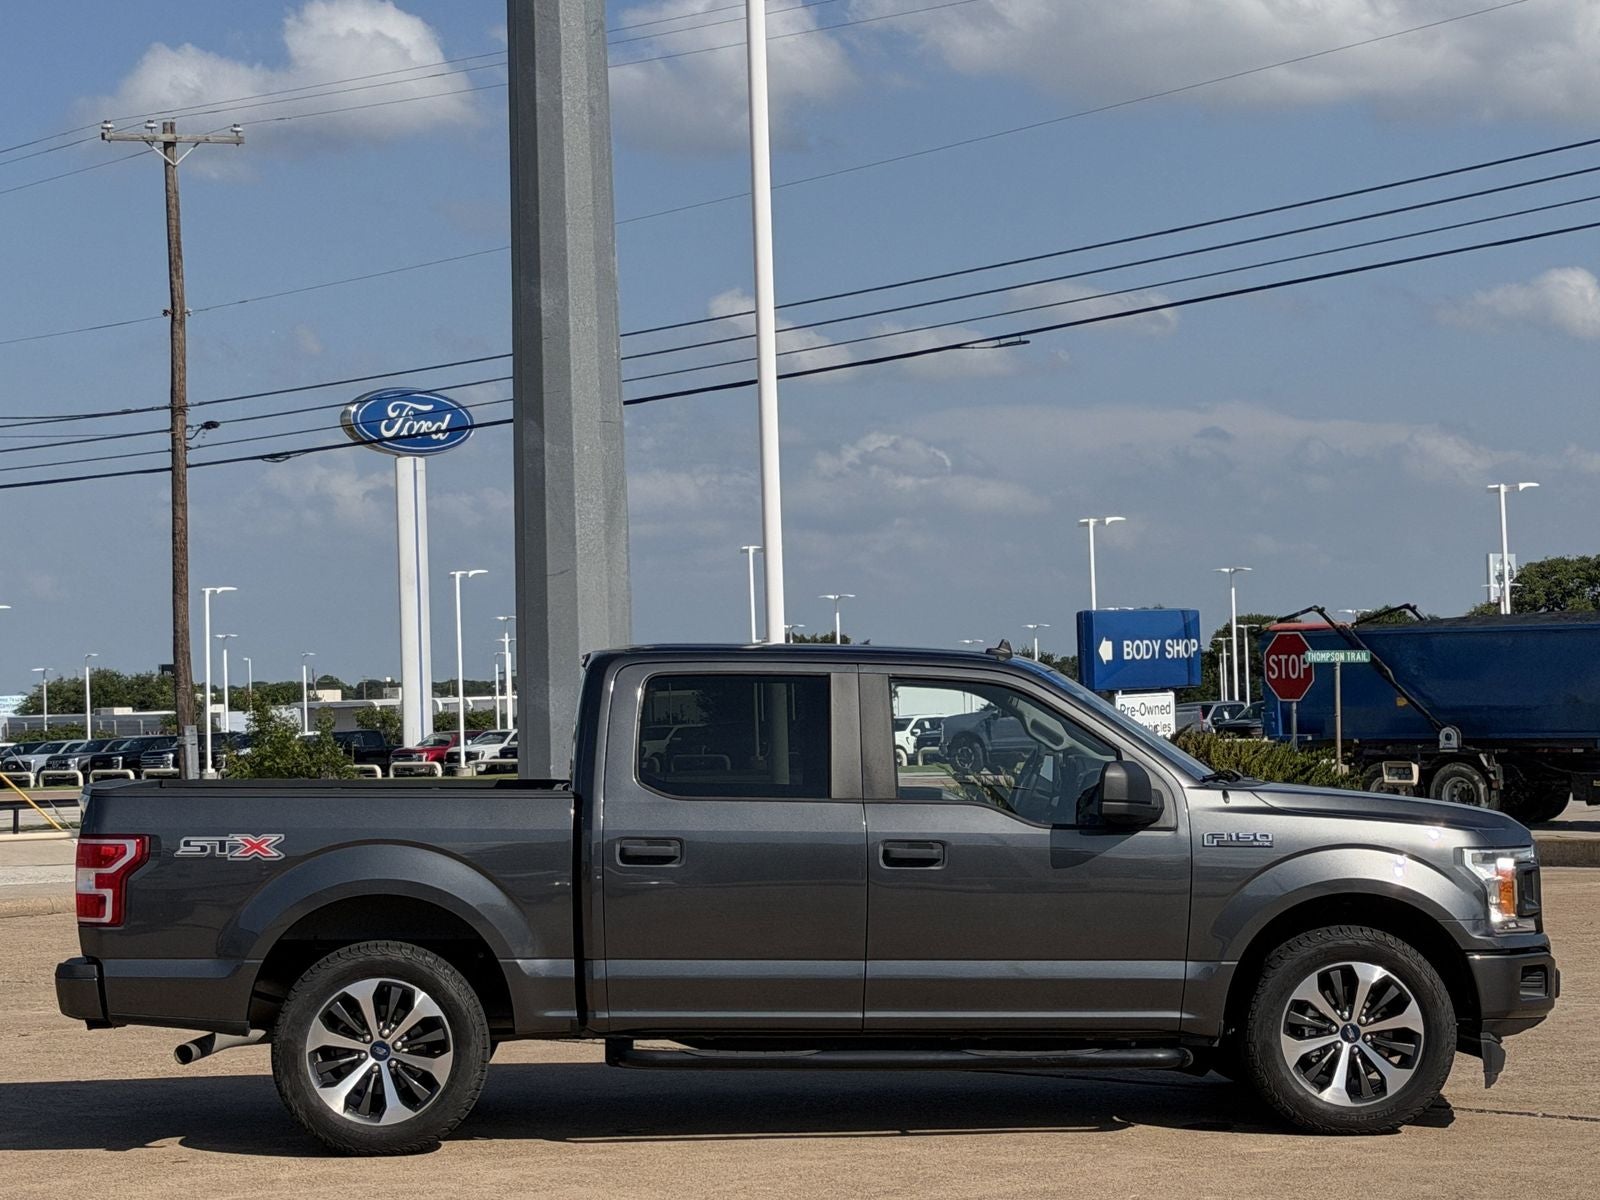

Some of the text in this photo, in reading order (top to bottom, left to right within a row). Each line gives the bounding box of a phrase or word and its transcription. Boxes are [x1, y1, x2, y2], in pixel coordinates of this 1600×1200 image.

[380, 401, 452, 440] Ford
[1123, 639, 1198, 660] BODY SHOP
[1307, 651, 1369, 662] THOMPSON TRAIL
[1268, 654, 1310, 679] STOP
[1120, 701, 1171, 717] Pre-Owned
[174, 834, 285, 860] STX
